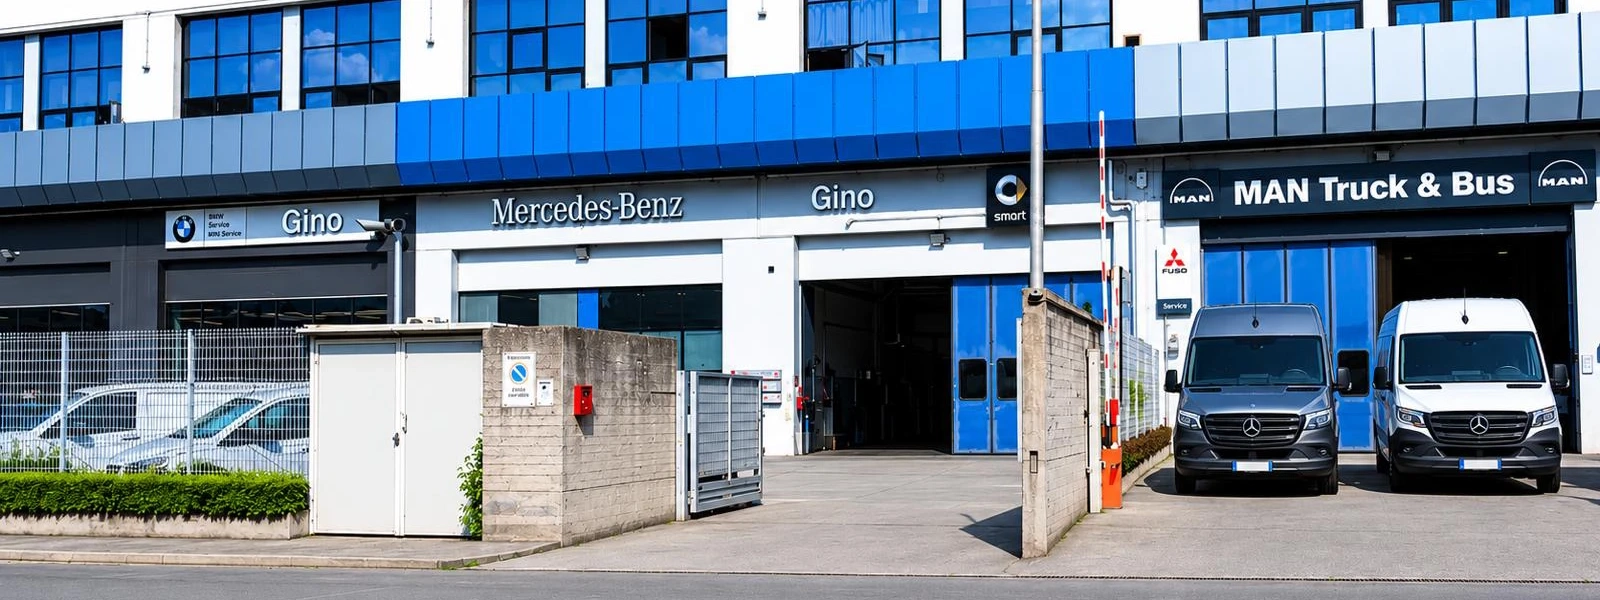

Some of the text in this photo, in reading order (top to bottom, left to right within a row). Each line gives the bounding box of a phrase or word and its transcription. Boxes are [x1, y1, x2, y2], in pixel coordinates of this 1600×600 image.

[1541, 176, 1584, 187] MAN
[1234, 171, 1515, 206] MAN Truck & Bus
[811, 184, 875, 211] Gino
[1173, 194, 1211, 204] MAN
[491, 192, 684, 226] Mercedes-Benz
[281, 208, 344, 235] Gino
[993, 210, 1027, 222] smart
[208, 221, 230, 229] Service
[221, 230, 242, 238] Service
[1162, 302, 1188, 310] Service
